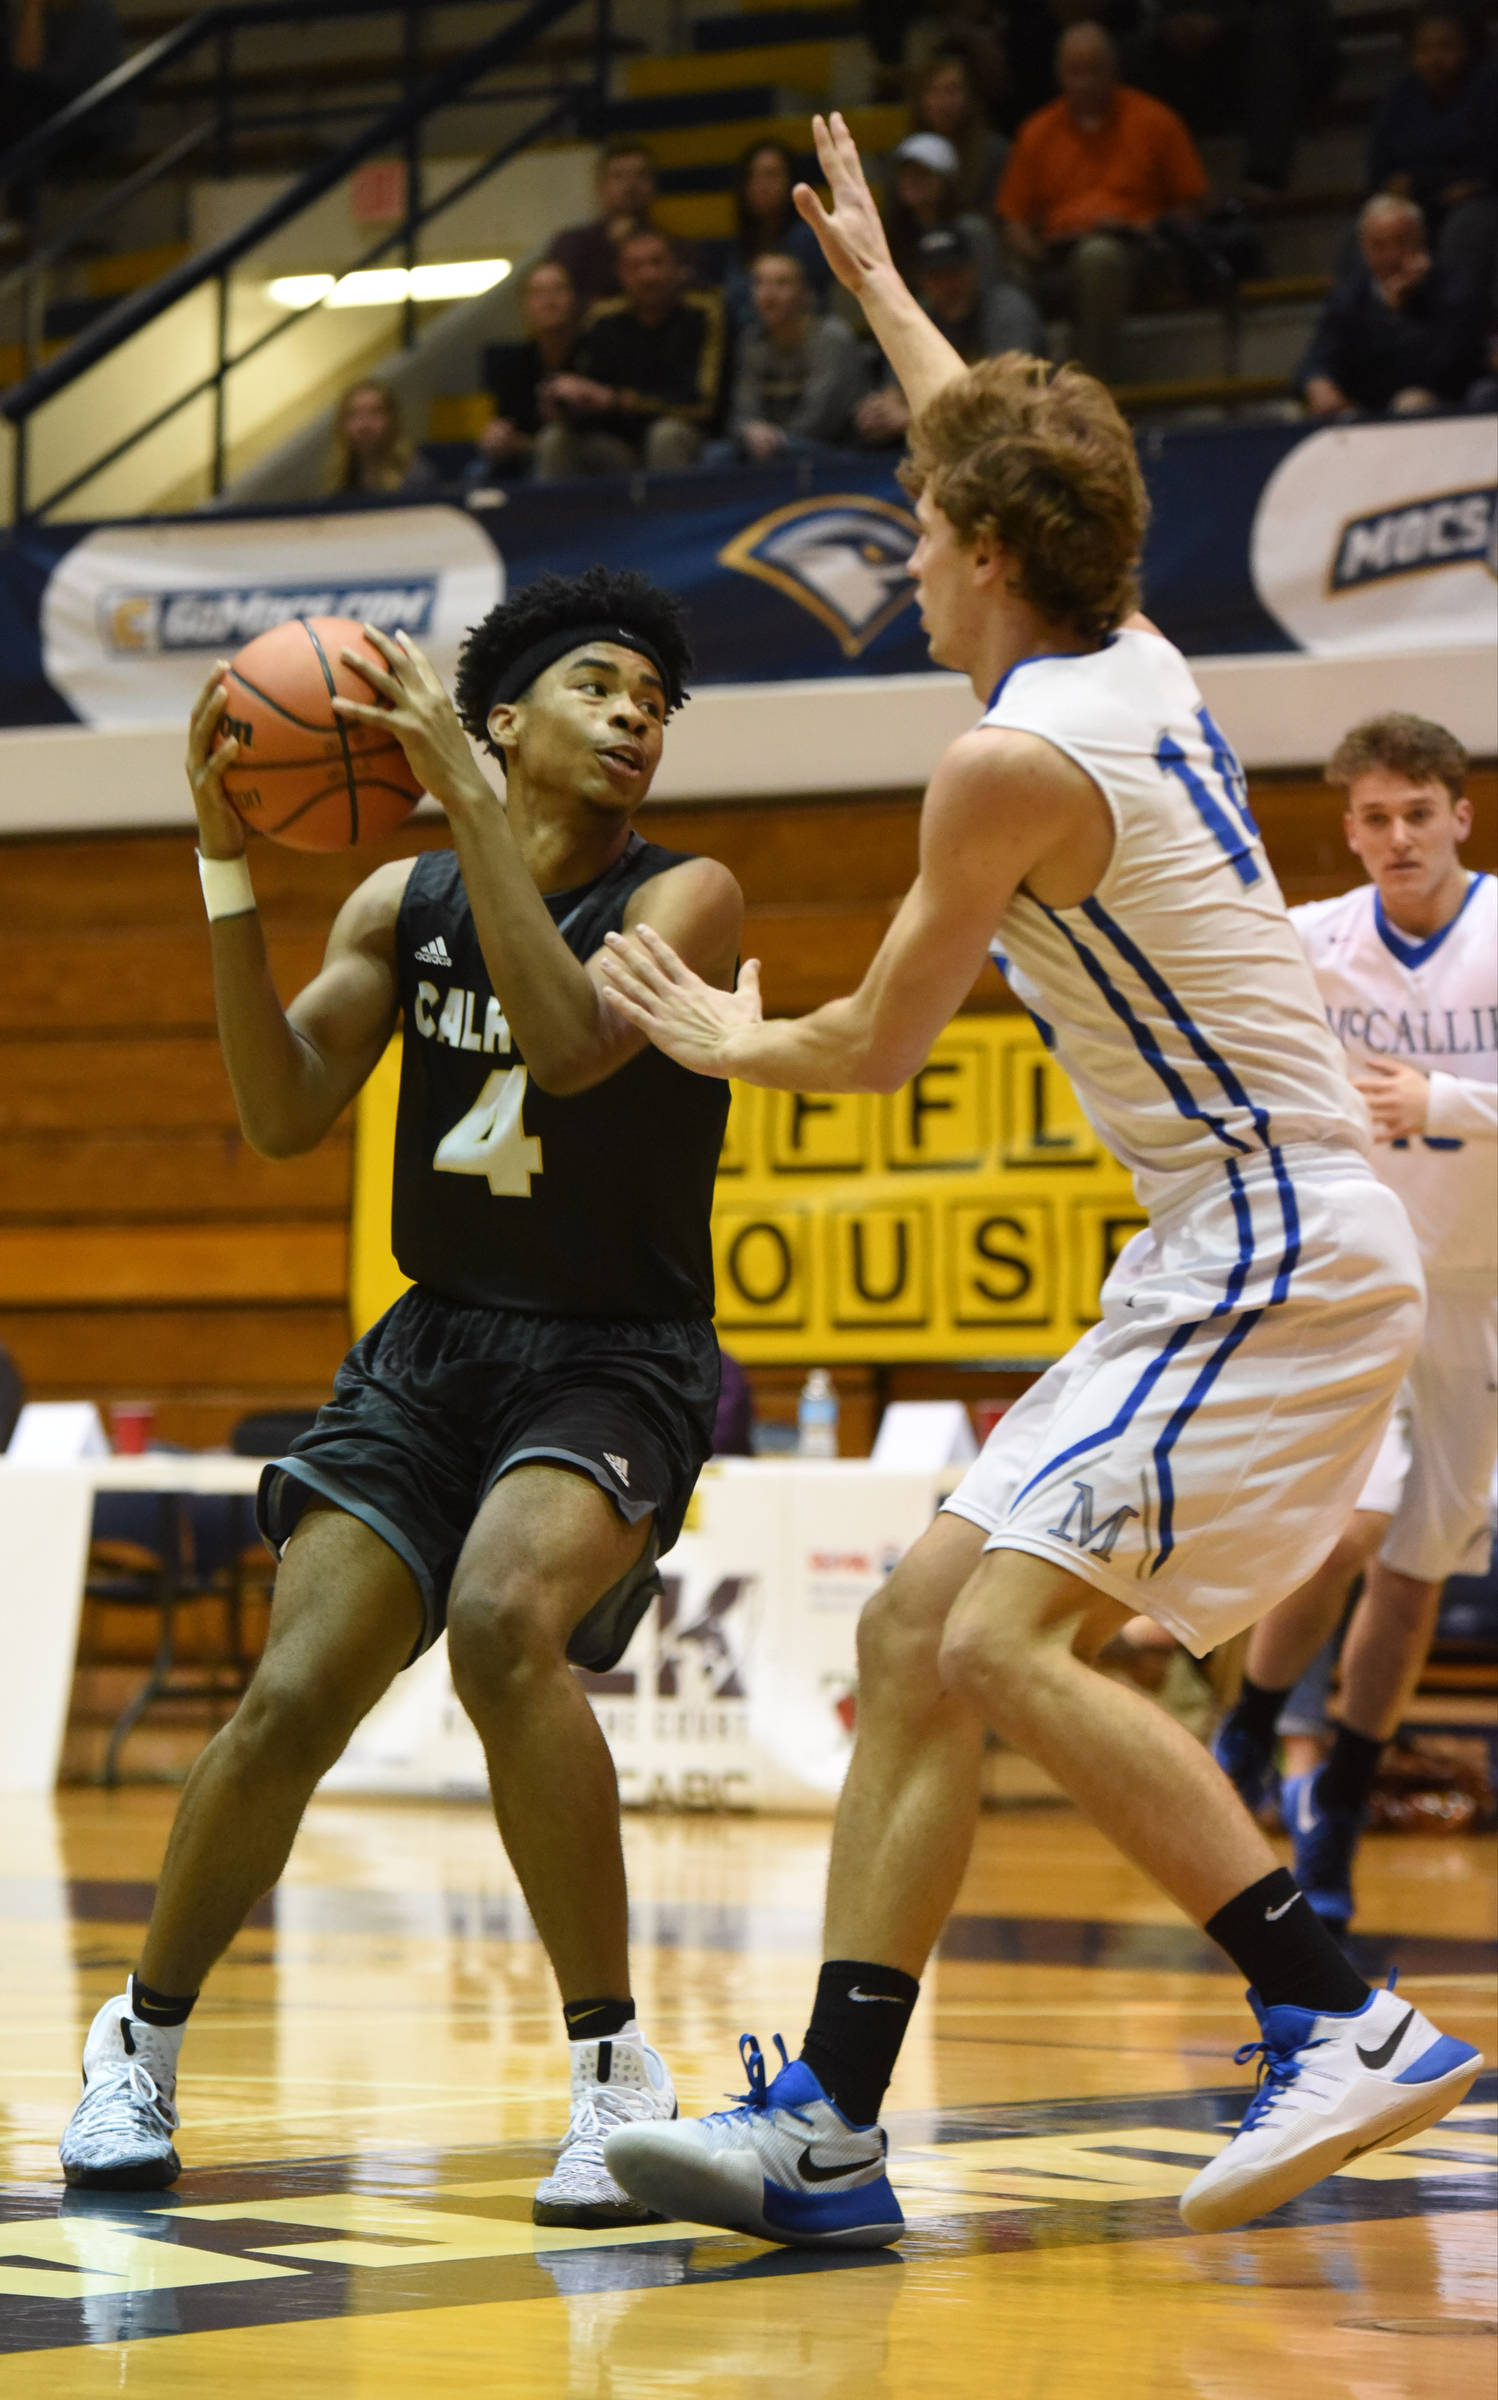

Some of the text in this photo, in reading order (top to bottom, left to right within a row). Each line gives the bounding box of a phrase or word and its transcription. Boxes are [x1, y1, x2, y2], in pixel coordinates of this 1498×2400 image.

[1340, 494, 1490, 580] MOCS
[414, 951, 453, 967] adidas
[414, 980, 512, 1054] CALH
[433, 1064, 544, 1198] 4
[791, 1063, 1074, 1150] FFL
[728, 1216, 1149, 1306] OUS
[1046, 1480, 1140, 1564] M
